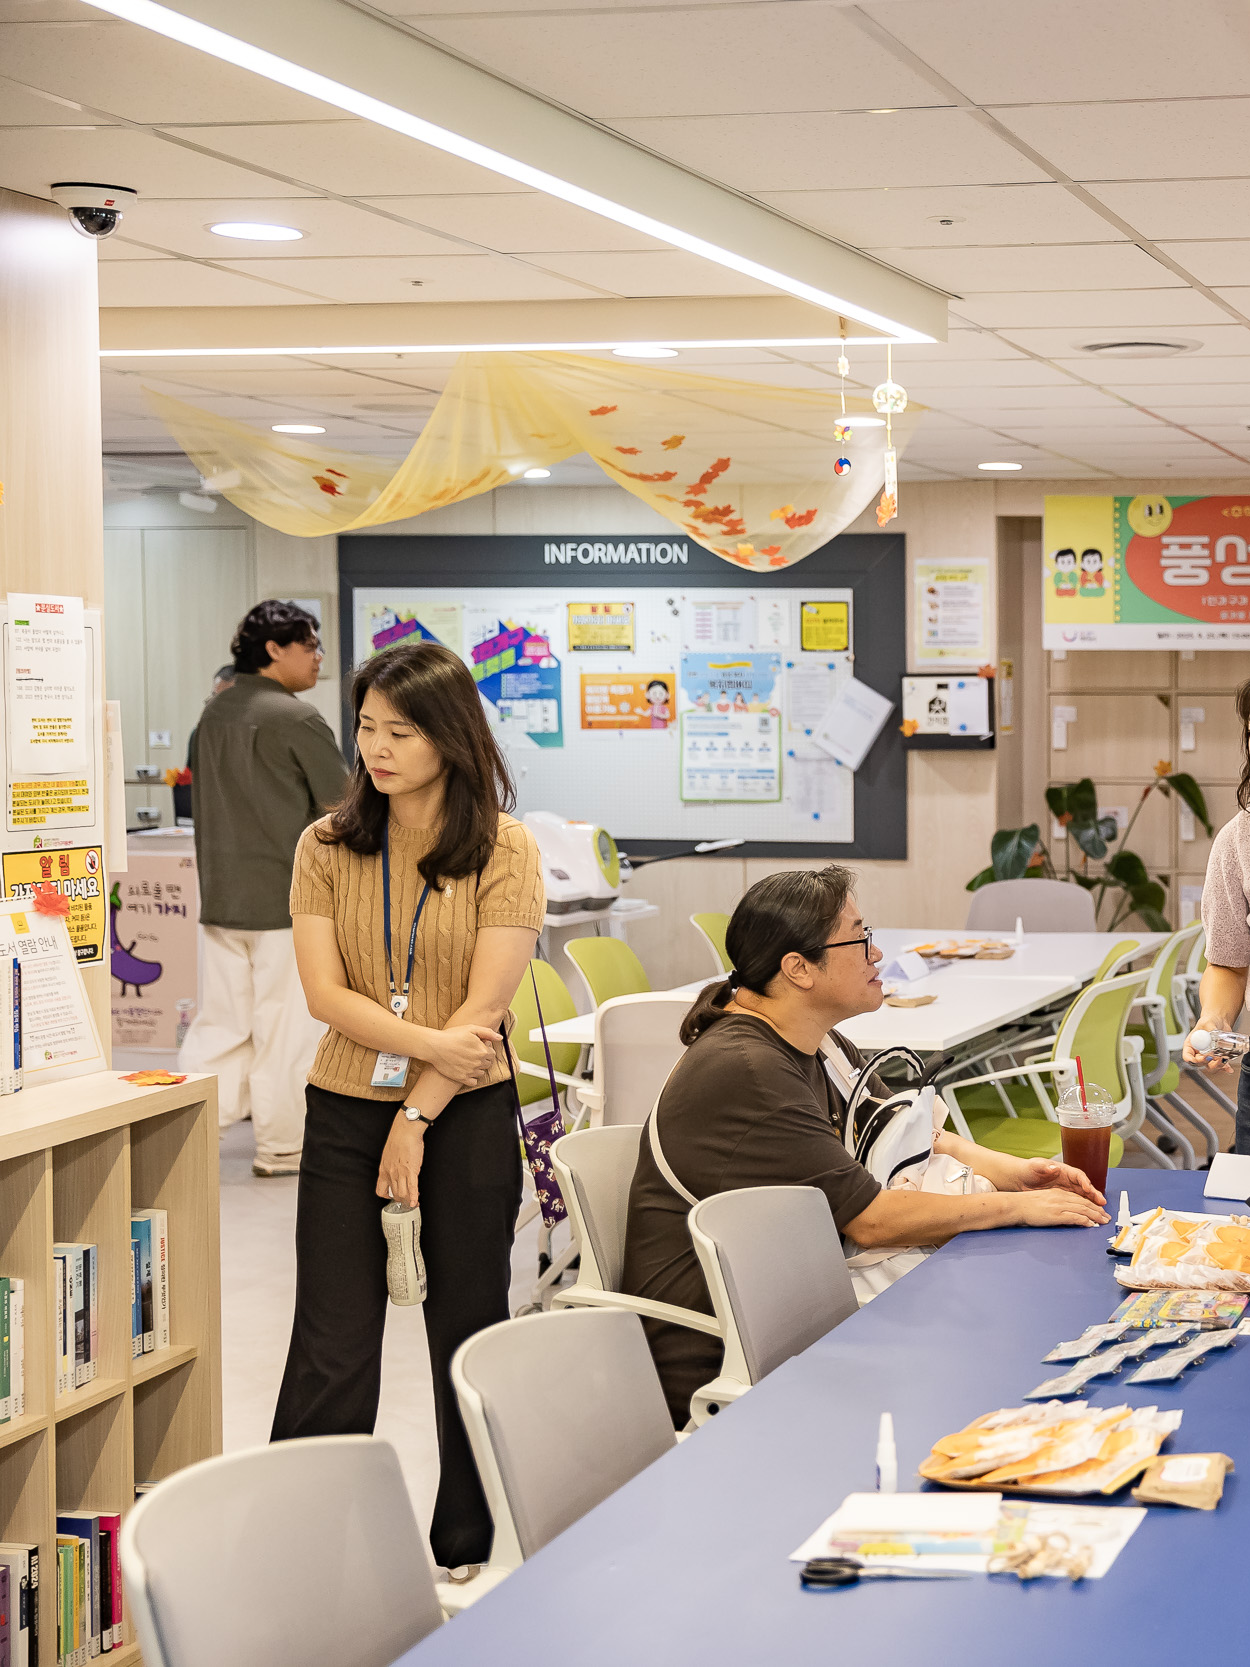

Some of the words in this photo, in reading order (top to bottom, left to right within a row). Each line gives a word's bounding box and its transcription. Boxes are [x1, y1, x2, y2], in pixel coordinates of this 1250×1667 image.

[544, 543, 689, 566] INFORMATION
[40, 856, 53, 878] 알
[59, 854, 70, 876] 림
[63, 877, 100, 902] 마세요
[126, 904, 151, 916] 여기
[154, 903, 186, 917] 가지
[18, 938, 37, 955] 열람
[38, 935, 58, 952] 안내
[31, 1563, 39, 1589] 2024
